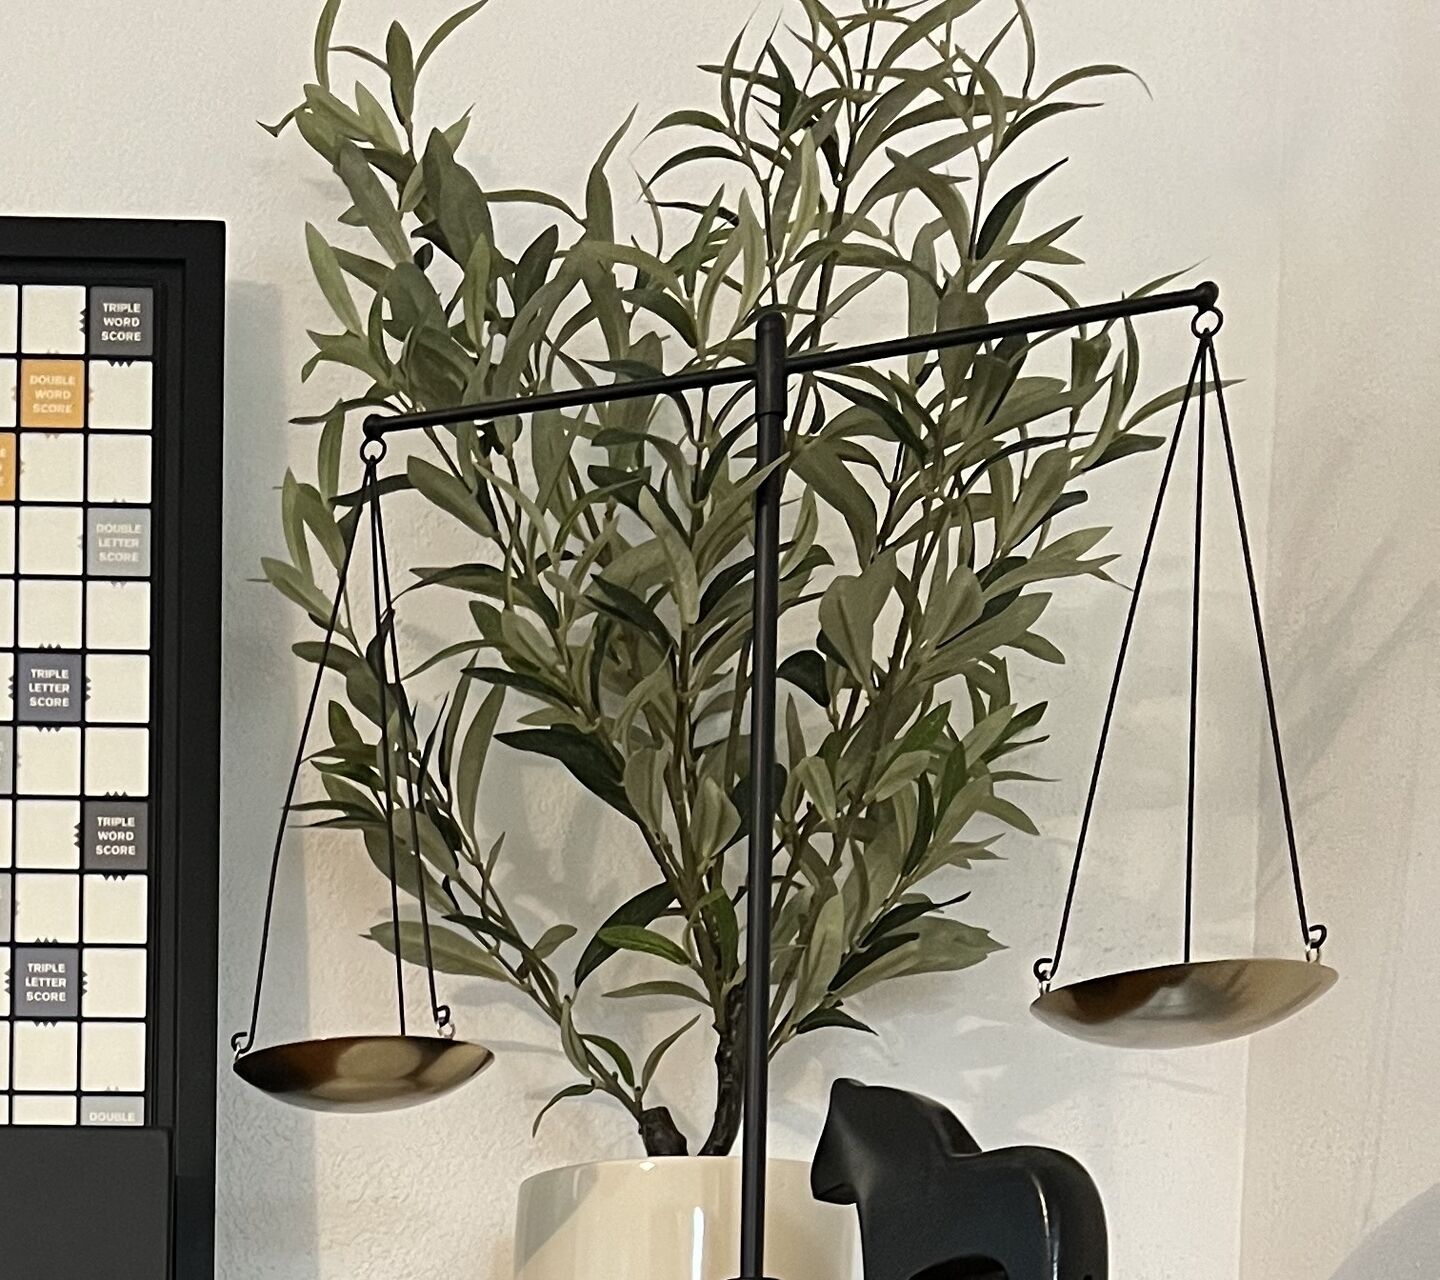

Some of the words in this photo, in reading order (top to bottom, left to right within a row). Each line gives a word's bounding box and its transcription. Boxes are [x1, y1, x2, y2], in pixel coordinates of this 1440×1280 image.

[97, 816, 135, 827] TRIPLE
[97, 831, 134, 841] WORD
[95, 845, 136, 855] SCORE
